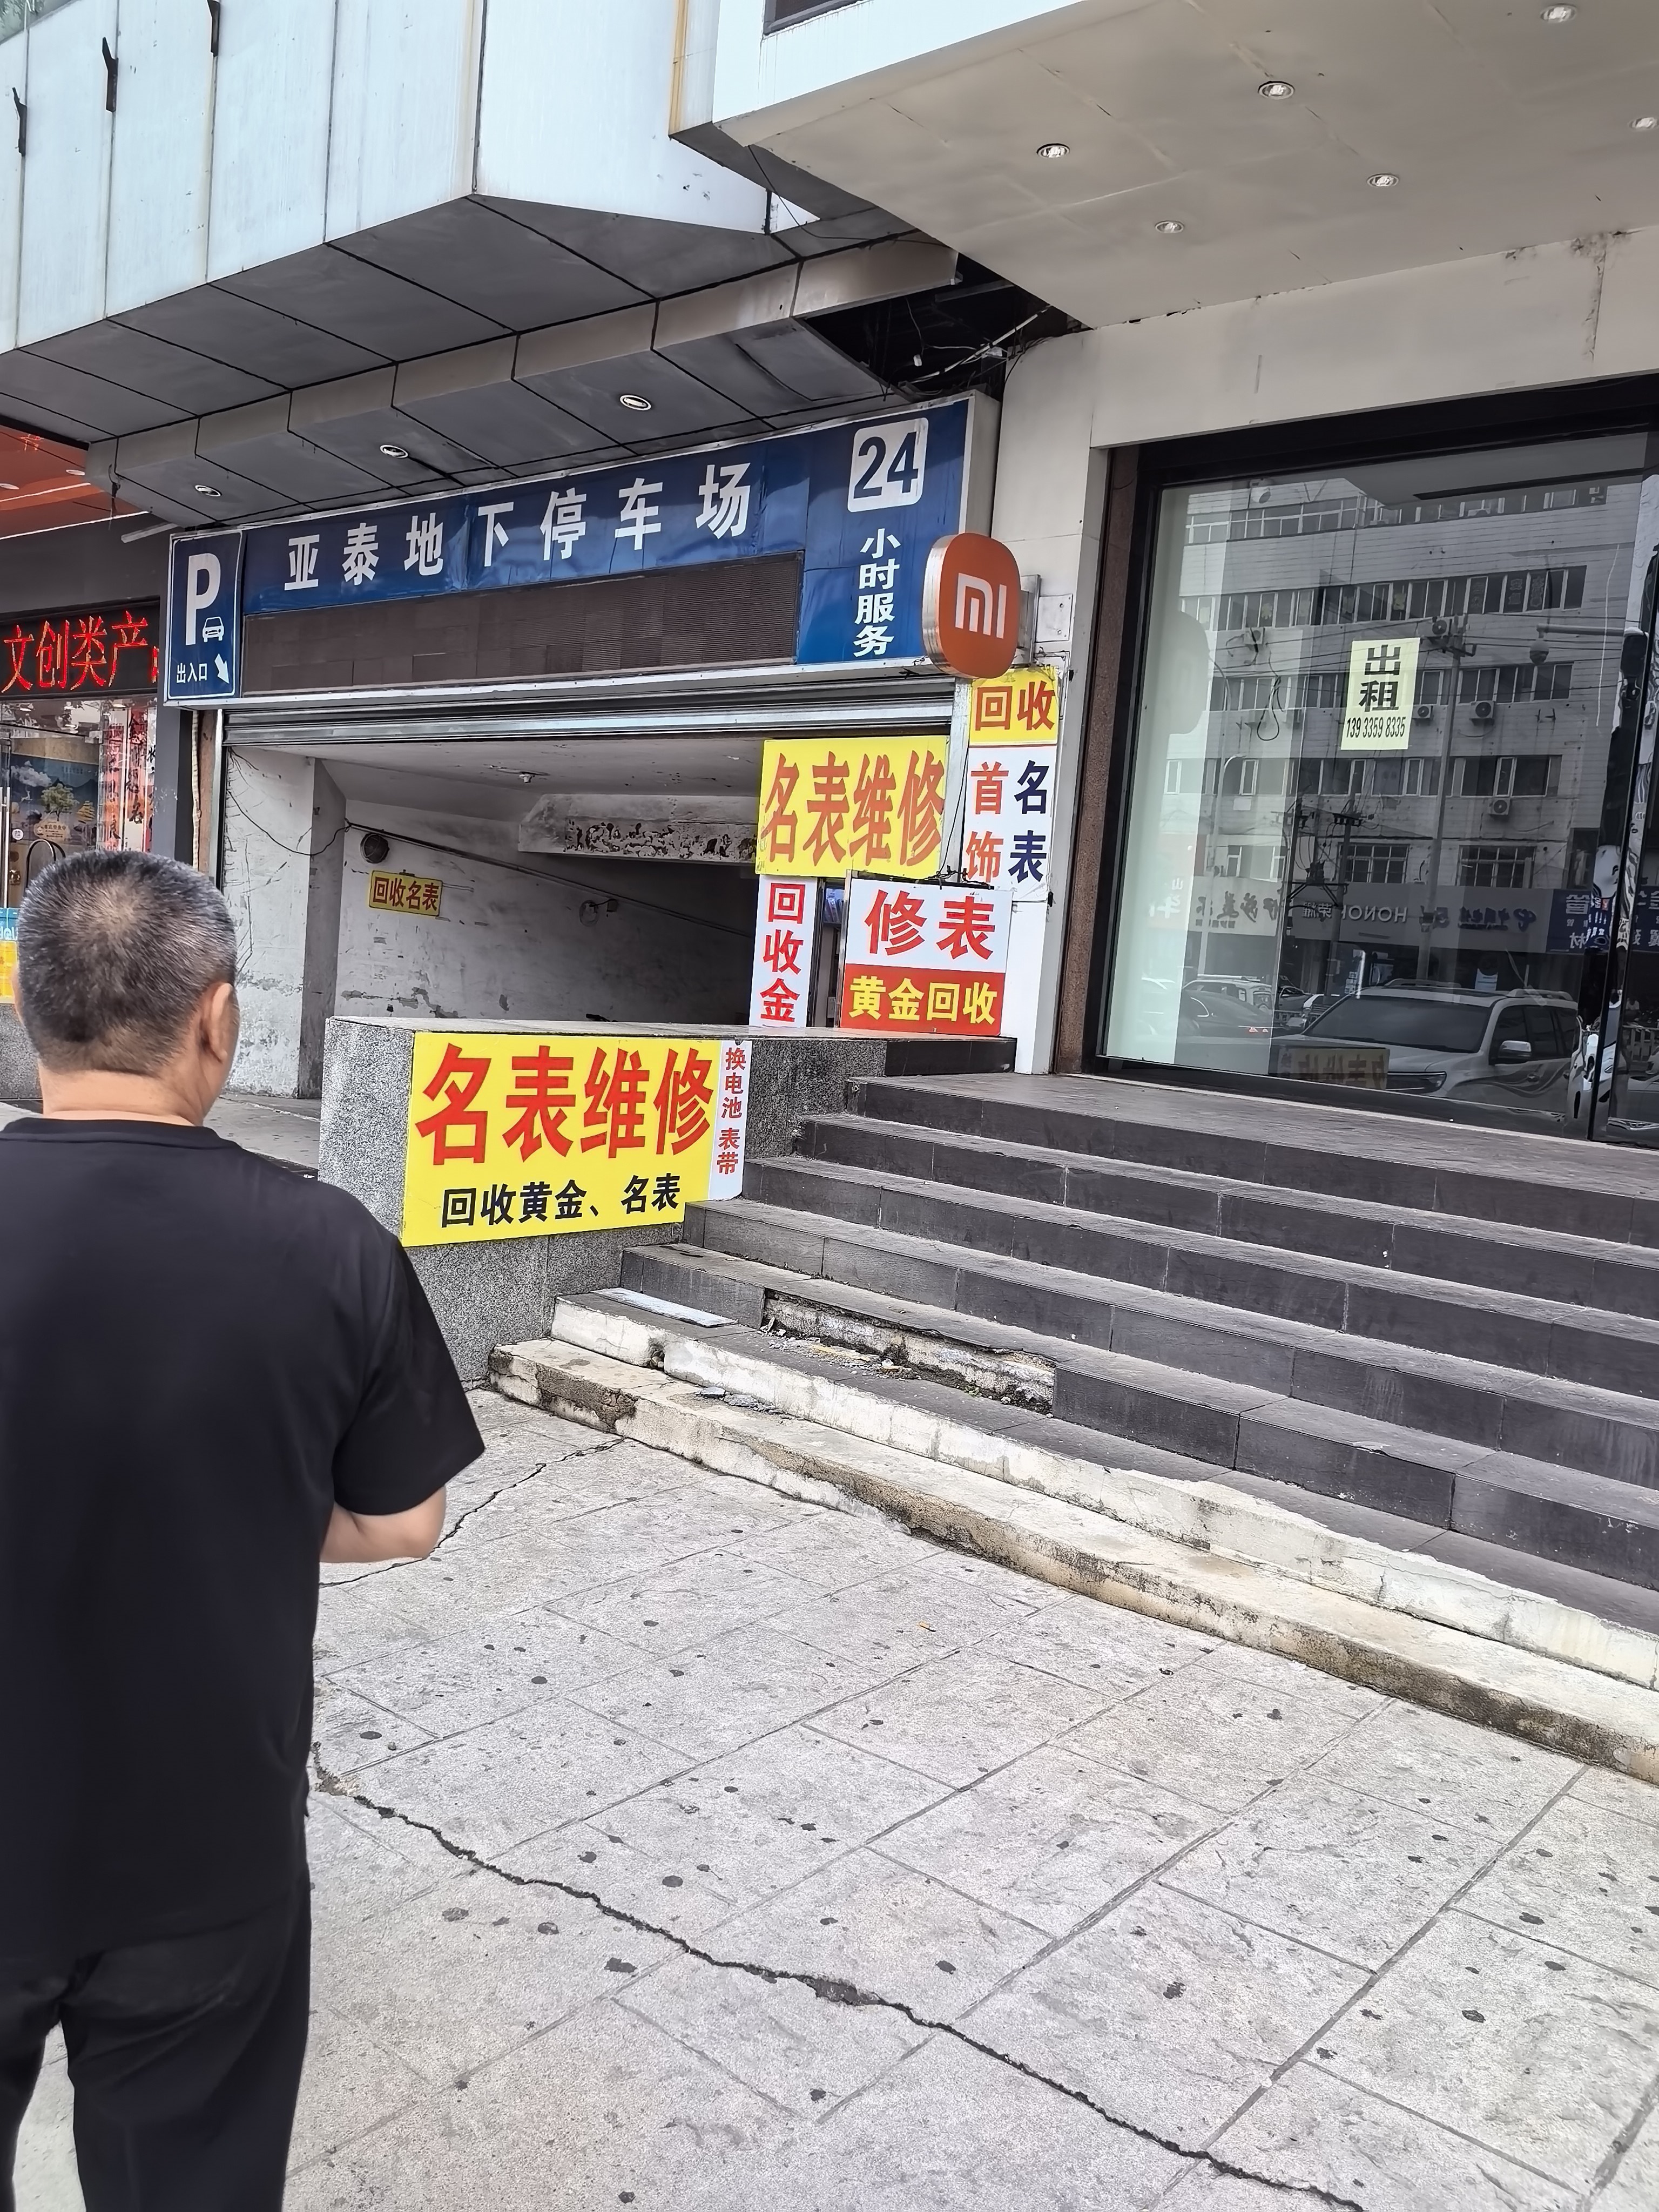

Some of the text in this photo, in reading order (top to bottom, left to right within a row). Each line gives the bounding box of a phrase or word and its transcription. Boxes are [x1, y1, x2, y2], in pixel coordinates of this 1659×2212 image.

[853, 431, 919, 500] 24
[284, 462, 751, 591] 亚泰地下停车场
[185, 552, 221, 646] P
[853, 528, 901, 658] 小时服务
[176, 662, 208, 684] 出入口
[975, 680, 1055, 731] 回收
[1359, 644, 1401, 712] 出租
[1346, 717, 1406, 738] 139 3359 8335
[761, 750, 946, 867] 名表维修
[965, 761, 1009, 883] 首饰
[1008, 759, 1049, 884] 名表
[373, 876, 440, 912] 回收名表
[864, 889, 996, 960] 修表
[760, 883, 805, 1023] 回收金
[849, 975, 999, 1025] 黄金回收
[415, 1043, 714, 1166] 名表维修
[716, 1047, 747, 1175] 换电池 表带
[441, 1172, 681, 1228] 回收黄金、名表
